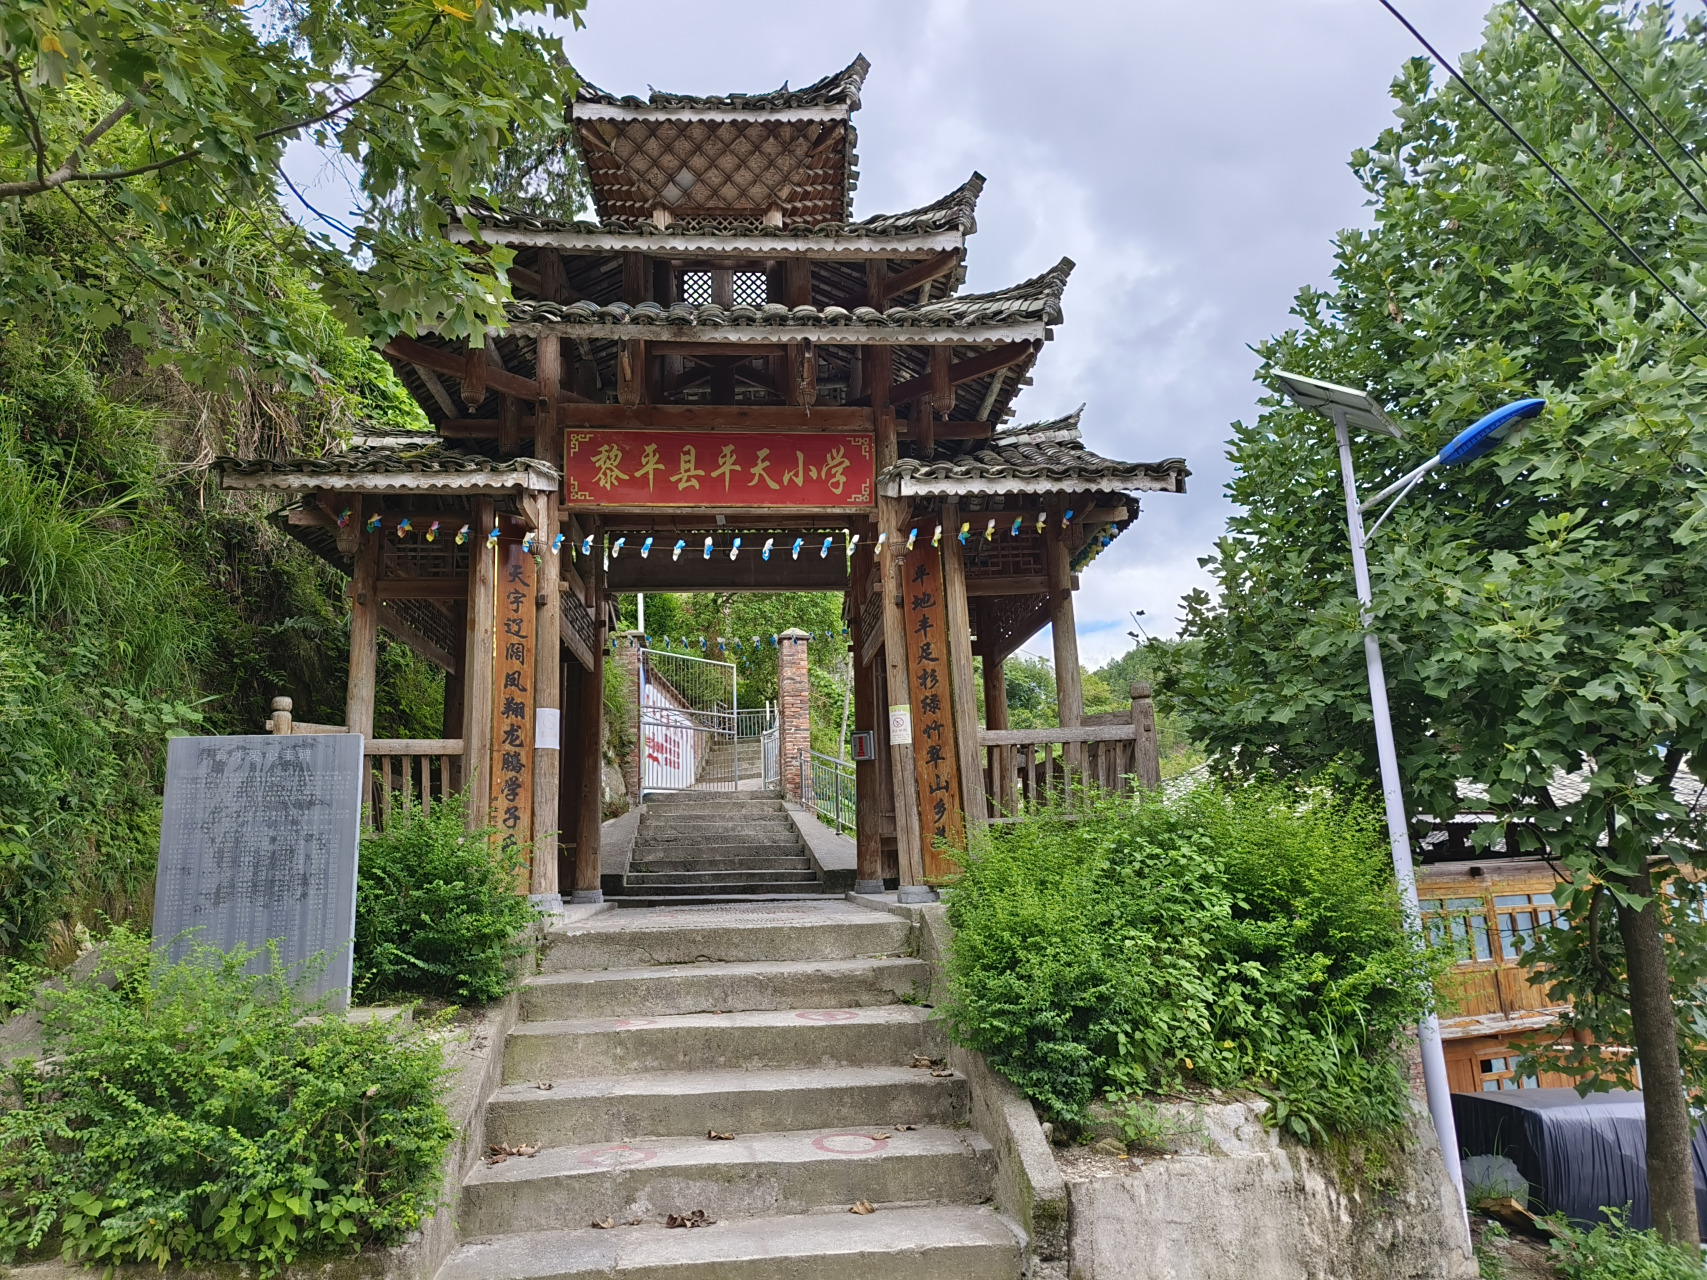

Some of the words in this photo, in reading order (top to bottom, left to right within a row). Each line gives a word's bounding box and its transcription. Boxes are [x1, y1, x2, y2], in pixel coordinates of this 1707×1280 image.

[590, 443, 851, 495] 黎平县平天小学
